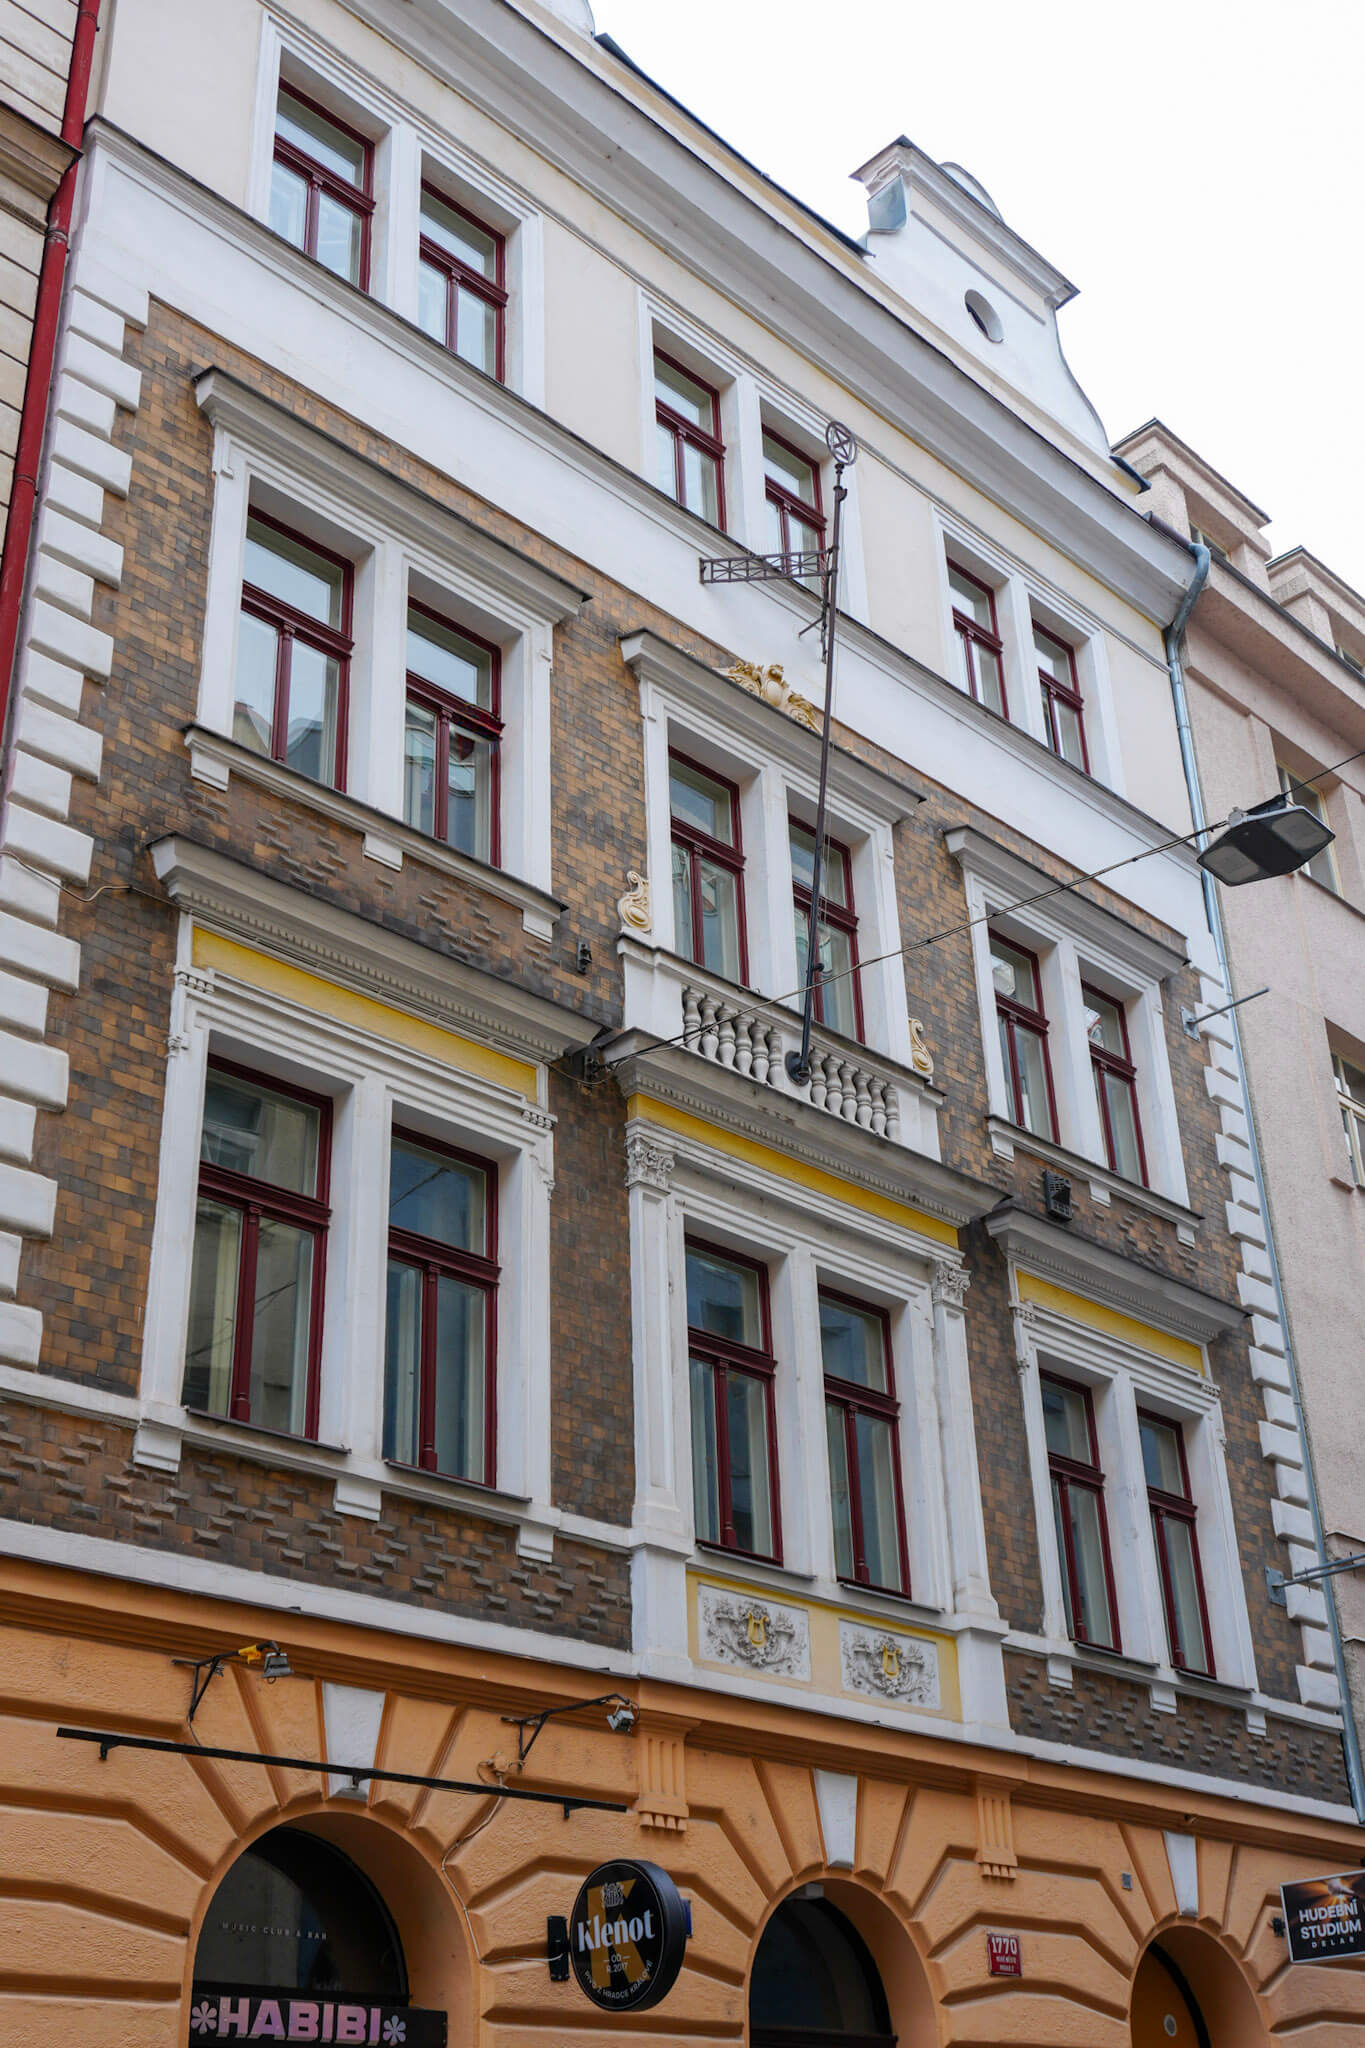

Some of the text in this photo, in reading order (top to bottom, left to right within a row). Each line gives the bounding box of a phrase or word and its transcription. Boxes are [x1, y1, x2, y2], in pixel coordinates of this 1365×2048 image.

[1299, 1899, 1358, 1922] HUDEBNÍ
[221, 1921, 256, 1933] MUSIC
[263, 1926, 290, 1937] CLUB
[577, 1909, 655, 1952] Klenot
[1300, 1919, 1362, 1939] STUDIUM
[991, 1936, 1017, 1955] 1770
[610, 1953, 622, 1963] OD
[215, 1996, 382, 2046] HABIBI
